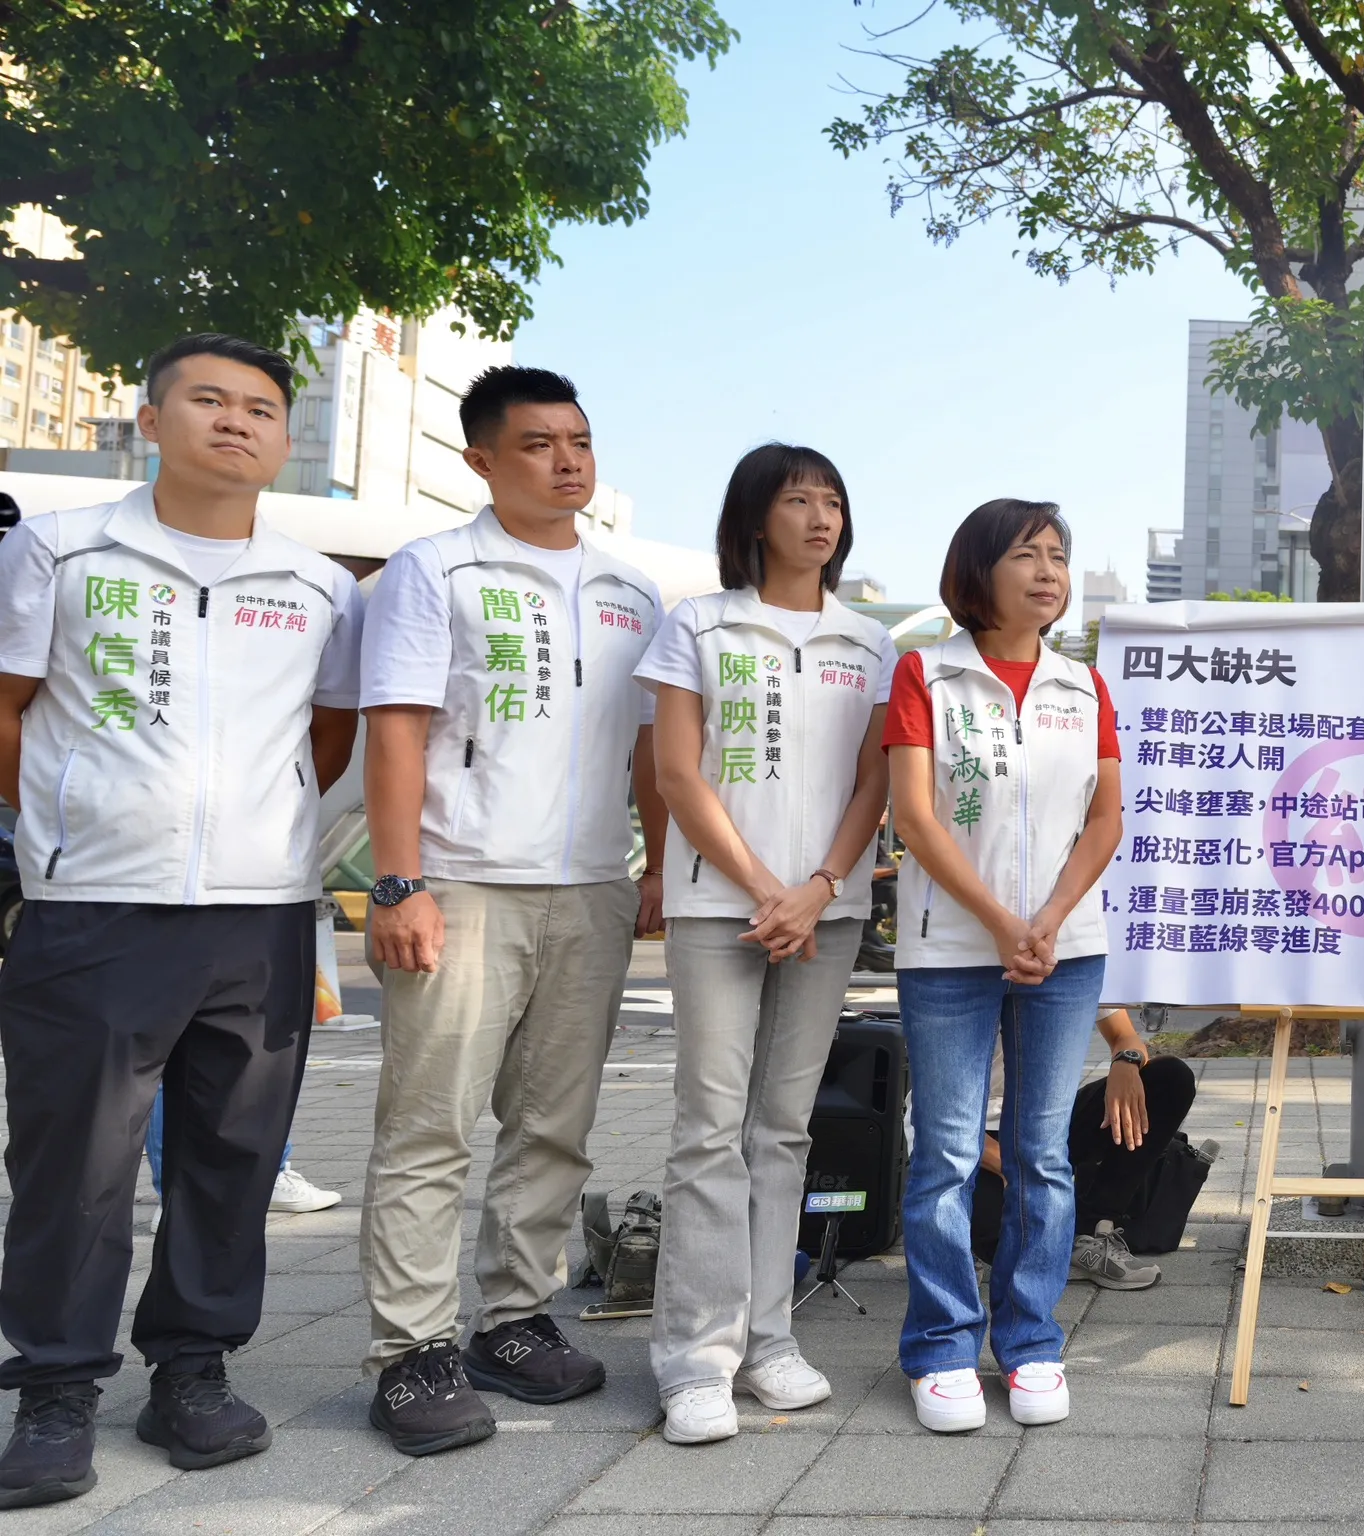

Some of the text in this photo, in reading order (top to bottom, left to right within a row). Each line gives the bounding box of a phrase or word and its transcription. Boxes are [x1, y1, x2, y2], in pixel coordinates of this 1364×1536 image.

[235, 594, 308, 612] 台中市長候選人
[595, 600, 640, 617] 台中市長候選人
[234, 606, 308, 632] 何欣純
[599, 609, 642, 635] 何欣純
[84, 575, 139, 731] 陳信秀
[479, 586, 527, 723] 簡嘉佑
[532, 613, 551, 719] 市議員參選人
[1123, 645, 1297, 687] 四大缺失
[149, 610, 172, 726] 市議員候選人
[818, 660, 867, 674] 台中市長候選人
[820, 669, 867, 692] 何欣純
[719, 652, 758, 784] 陳映辰
[1035, 704, 1084, 715] 台中市長候選人
[1037, 713, 1084, 733] 何欣純
[765, 675, 782, 780] 市議員參選人
[990, 727, 1008, 777] 市議員
[1137, 739, 1285, 771] 新車沒人開
[945, 703, 989, 836] 陳淑華
[1125, 921, 1342, 956] 捷運藍線零進度
[811, 1194, 862, 1207] CTS 華視
[432, 1341, 447, 1349] 1080
[495, 1340, 532, 1364] N
[385, 1383, 416, 1410] N
